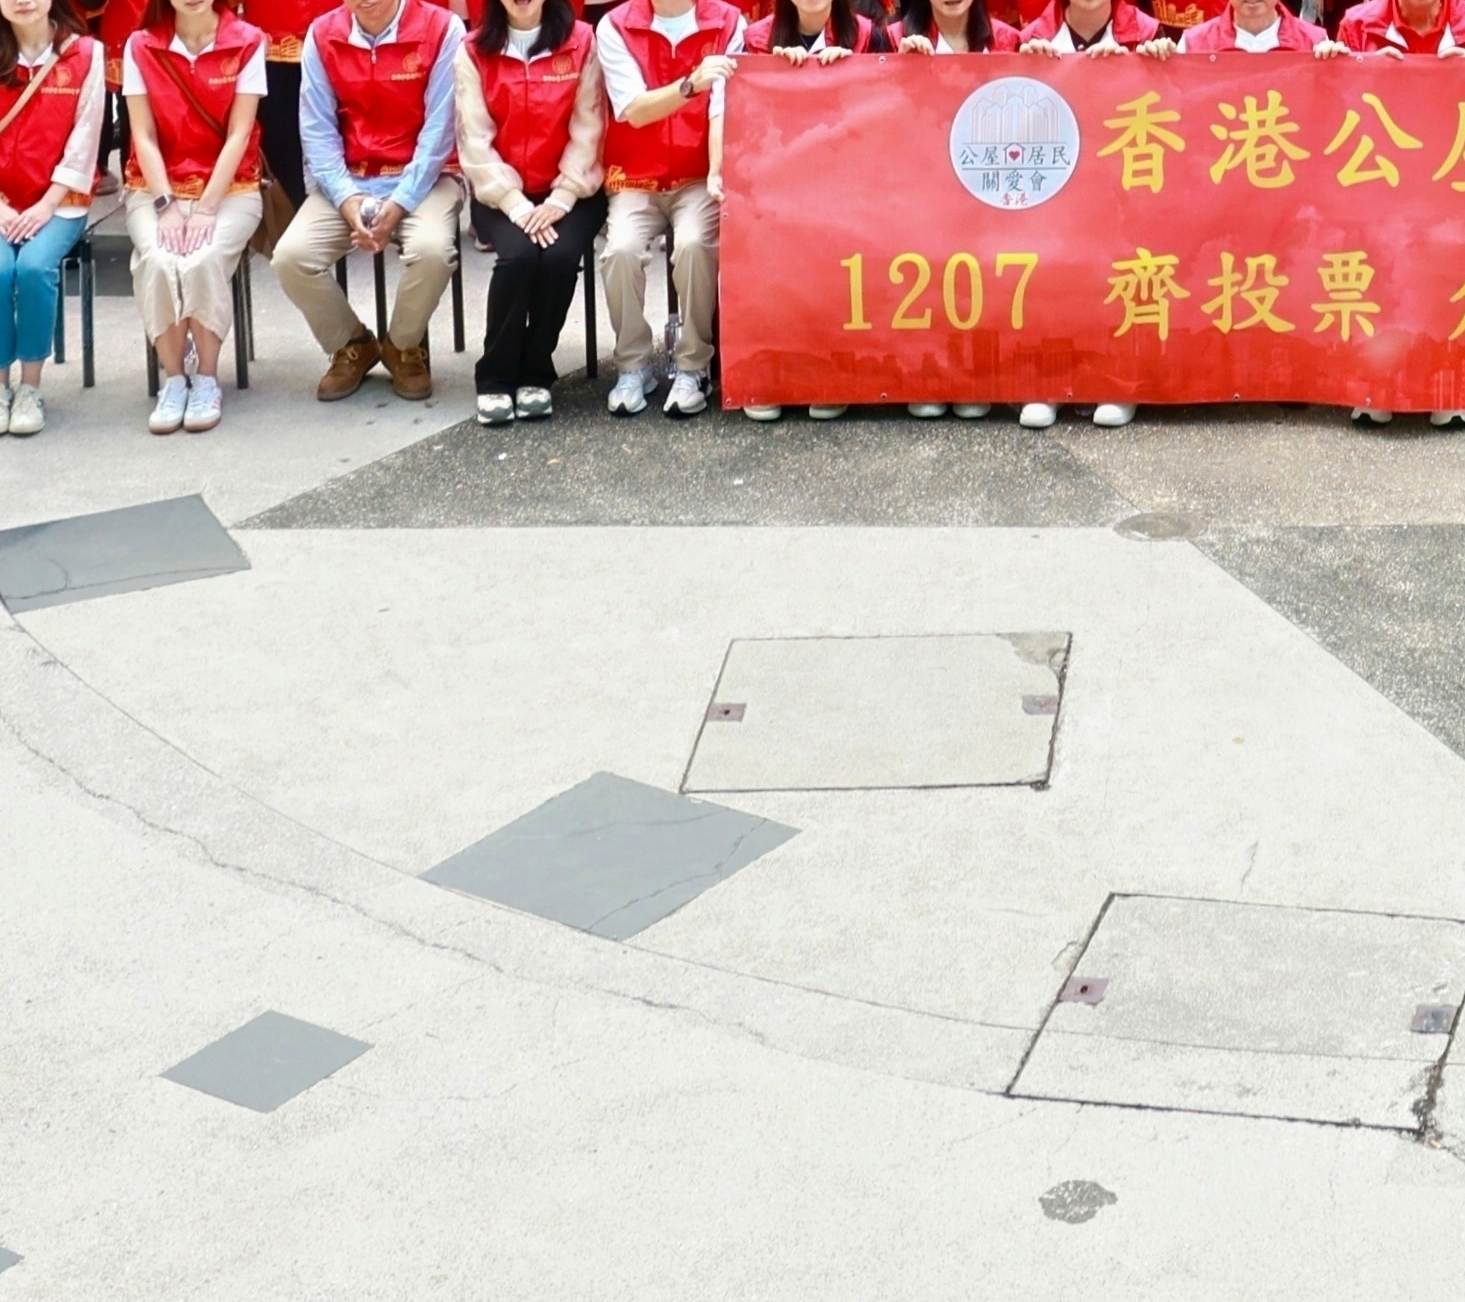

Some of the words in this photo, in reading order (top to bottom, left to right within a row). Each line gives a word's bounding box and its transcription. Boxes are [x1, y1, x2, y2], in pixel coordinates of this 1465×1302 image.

[982, 169, 1047, 192] 關愛會
[841, 249, 1038, 332] 1207
[1104, 247, 1381, 345] 齊投票
